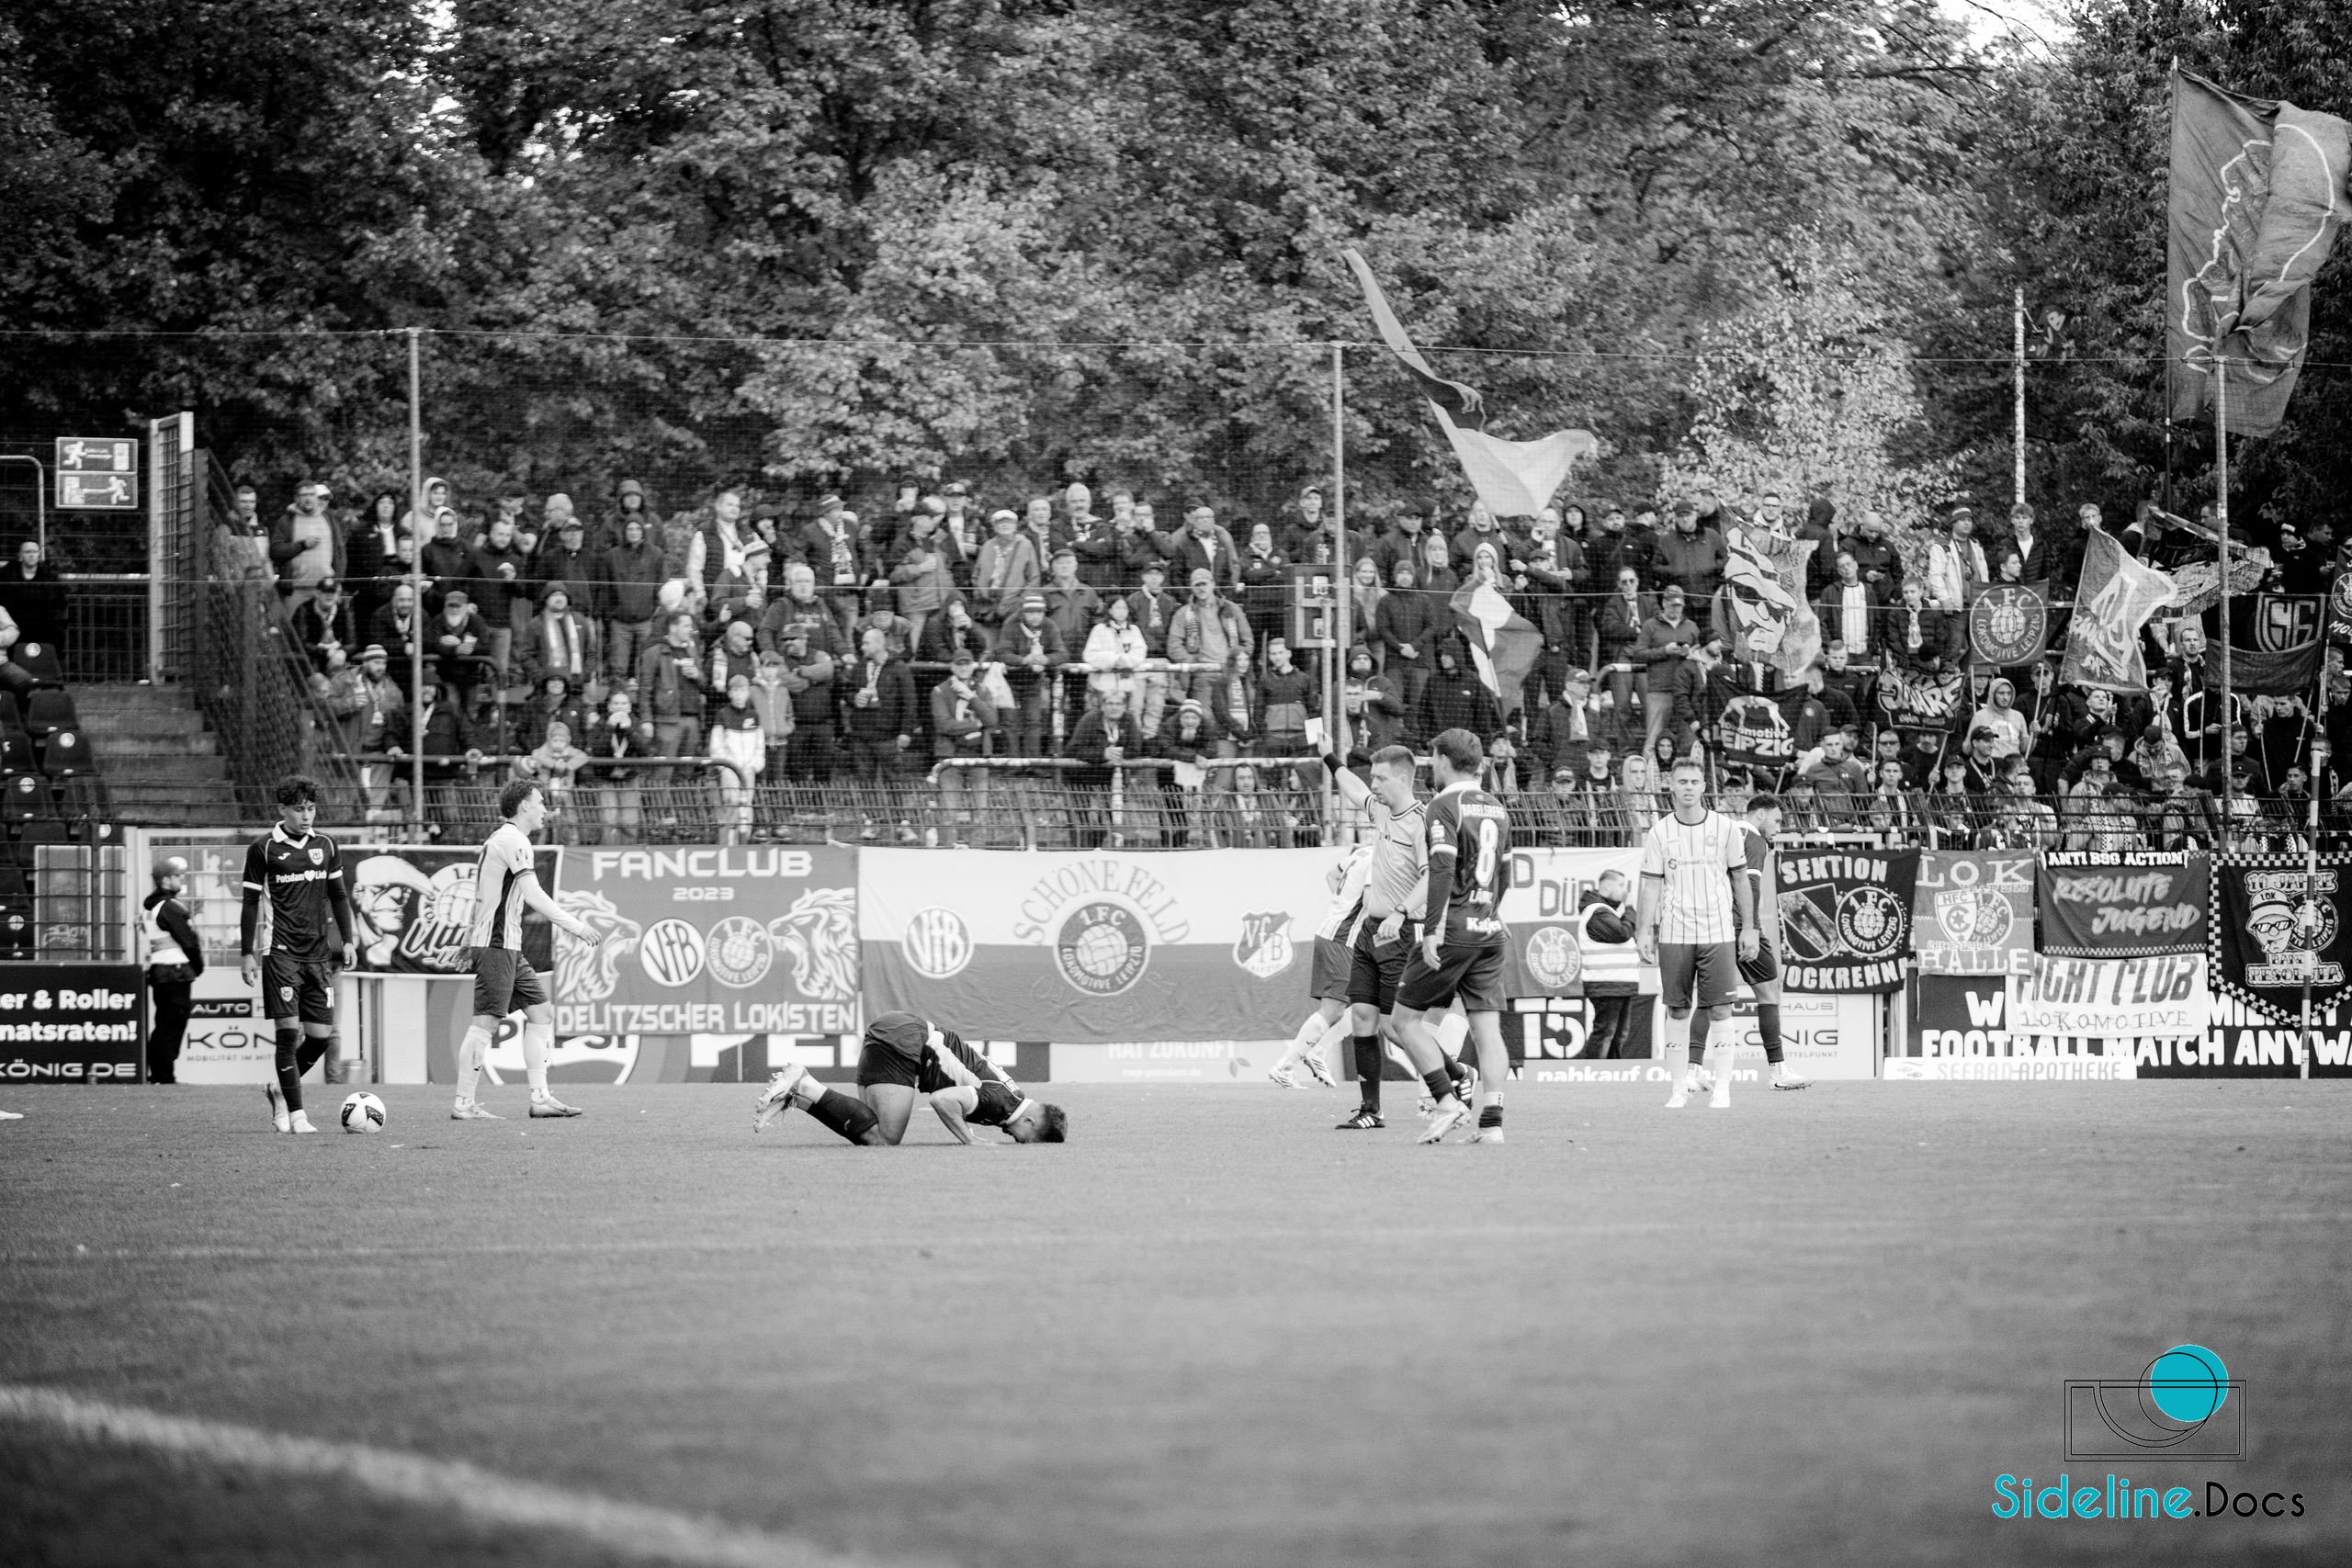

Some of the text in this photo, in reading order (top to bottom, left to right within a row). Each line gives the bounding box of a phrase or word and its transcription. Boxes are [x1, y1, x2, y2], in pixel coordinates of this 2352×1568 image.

[1984, 588, 2032, 614] 1.FC
[1976, 618, 2019, 660] LOKOMOTIVE
[2020, 613, 2041, 652] LEIPZIG
[1712, 724, 1795, 757] LEIPZIG
[593, 848, 813, 881] FANCLUB
[1475, 818, 1499, 887] 8
[2048, 852, 2088, 866] ANTI
[2124, 852, 2183, 866] ACTION
[1781, 855, 1888, 885] SEKTION
[1915, 854, 2034, 887] LOK
[673, 886, 735, 901] 2023
[1013, 859, 1191, 945] SCHÖNEFELD
[1849, 891, 1892, 913] 1.FC
[1942, 894, 1967, 905] HFC
[2053, 872, 2174, 906] RESOLUTE
[1841, 913, 1898, 951] LOKOMOTIVE LEIPZIG
[2091, 901, 2201, 936] JUGEND
[2312, 919, 2335, 948] LEIPZIG
[1917, 947, 2031, 974] HALLE
[2111, 954, 2199, 1006] CLUB
[32, 991, 52, 1010] &
[58, 988, 136, 1010] Roller
[190, 1001, 252, 1014] AUTO
[0, 1021, 137, 1041] natsraten!
[556, 1000, 856, 1033] DELITZSCHER LOKISTEN
[2017, 1010, 2193, 1032] LOKOMOTIVE
[1922, 1029, 2352, 1066] FOOTBALL MATCH ANYW
[1536, 1066, 1641, 1082] nahkauf
[1937, 1062, 2121, 1081] SEEBAD-APOTHEKE
